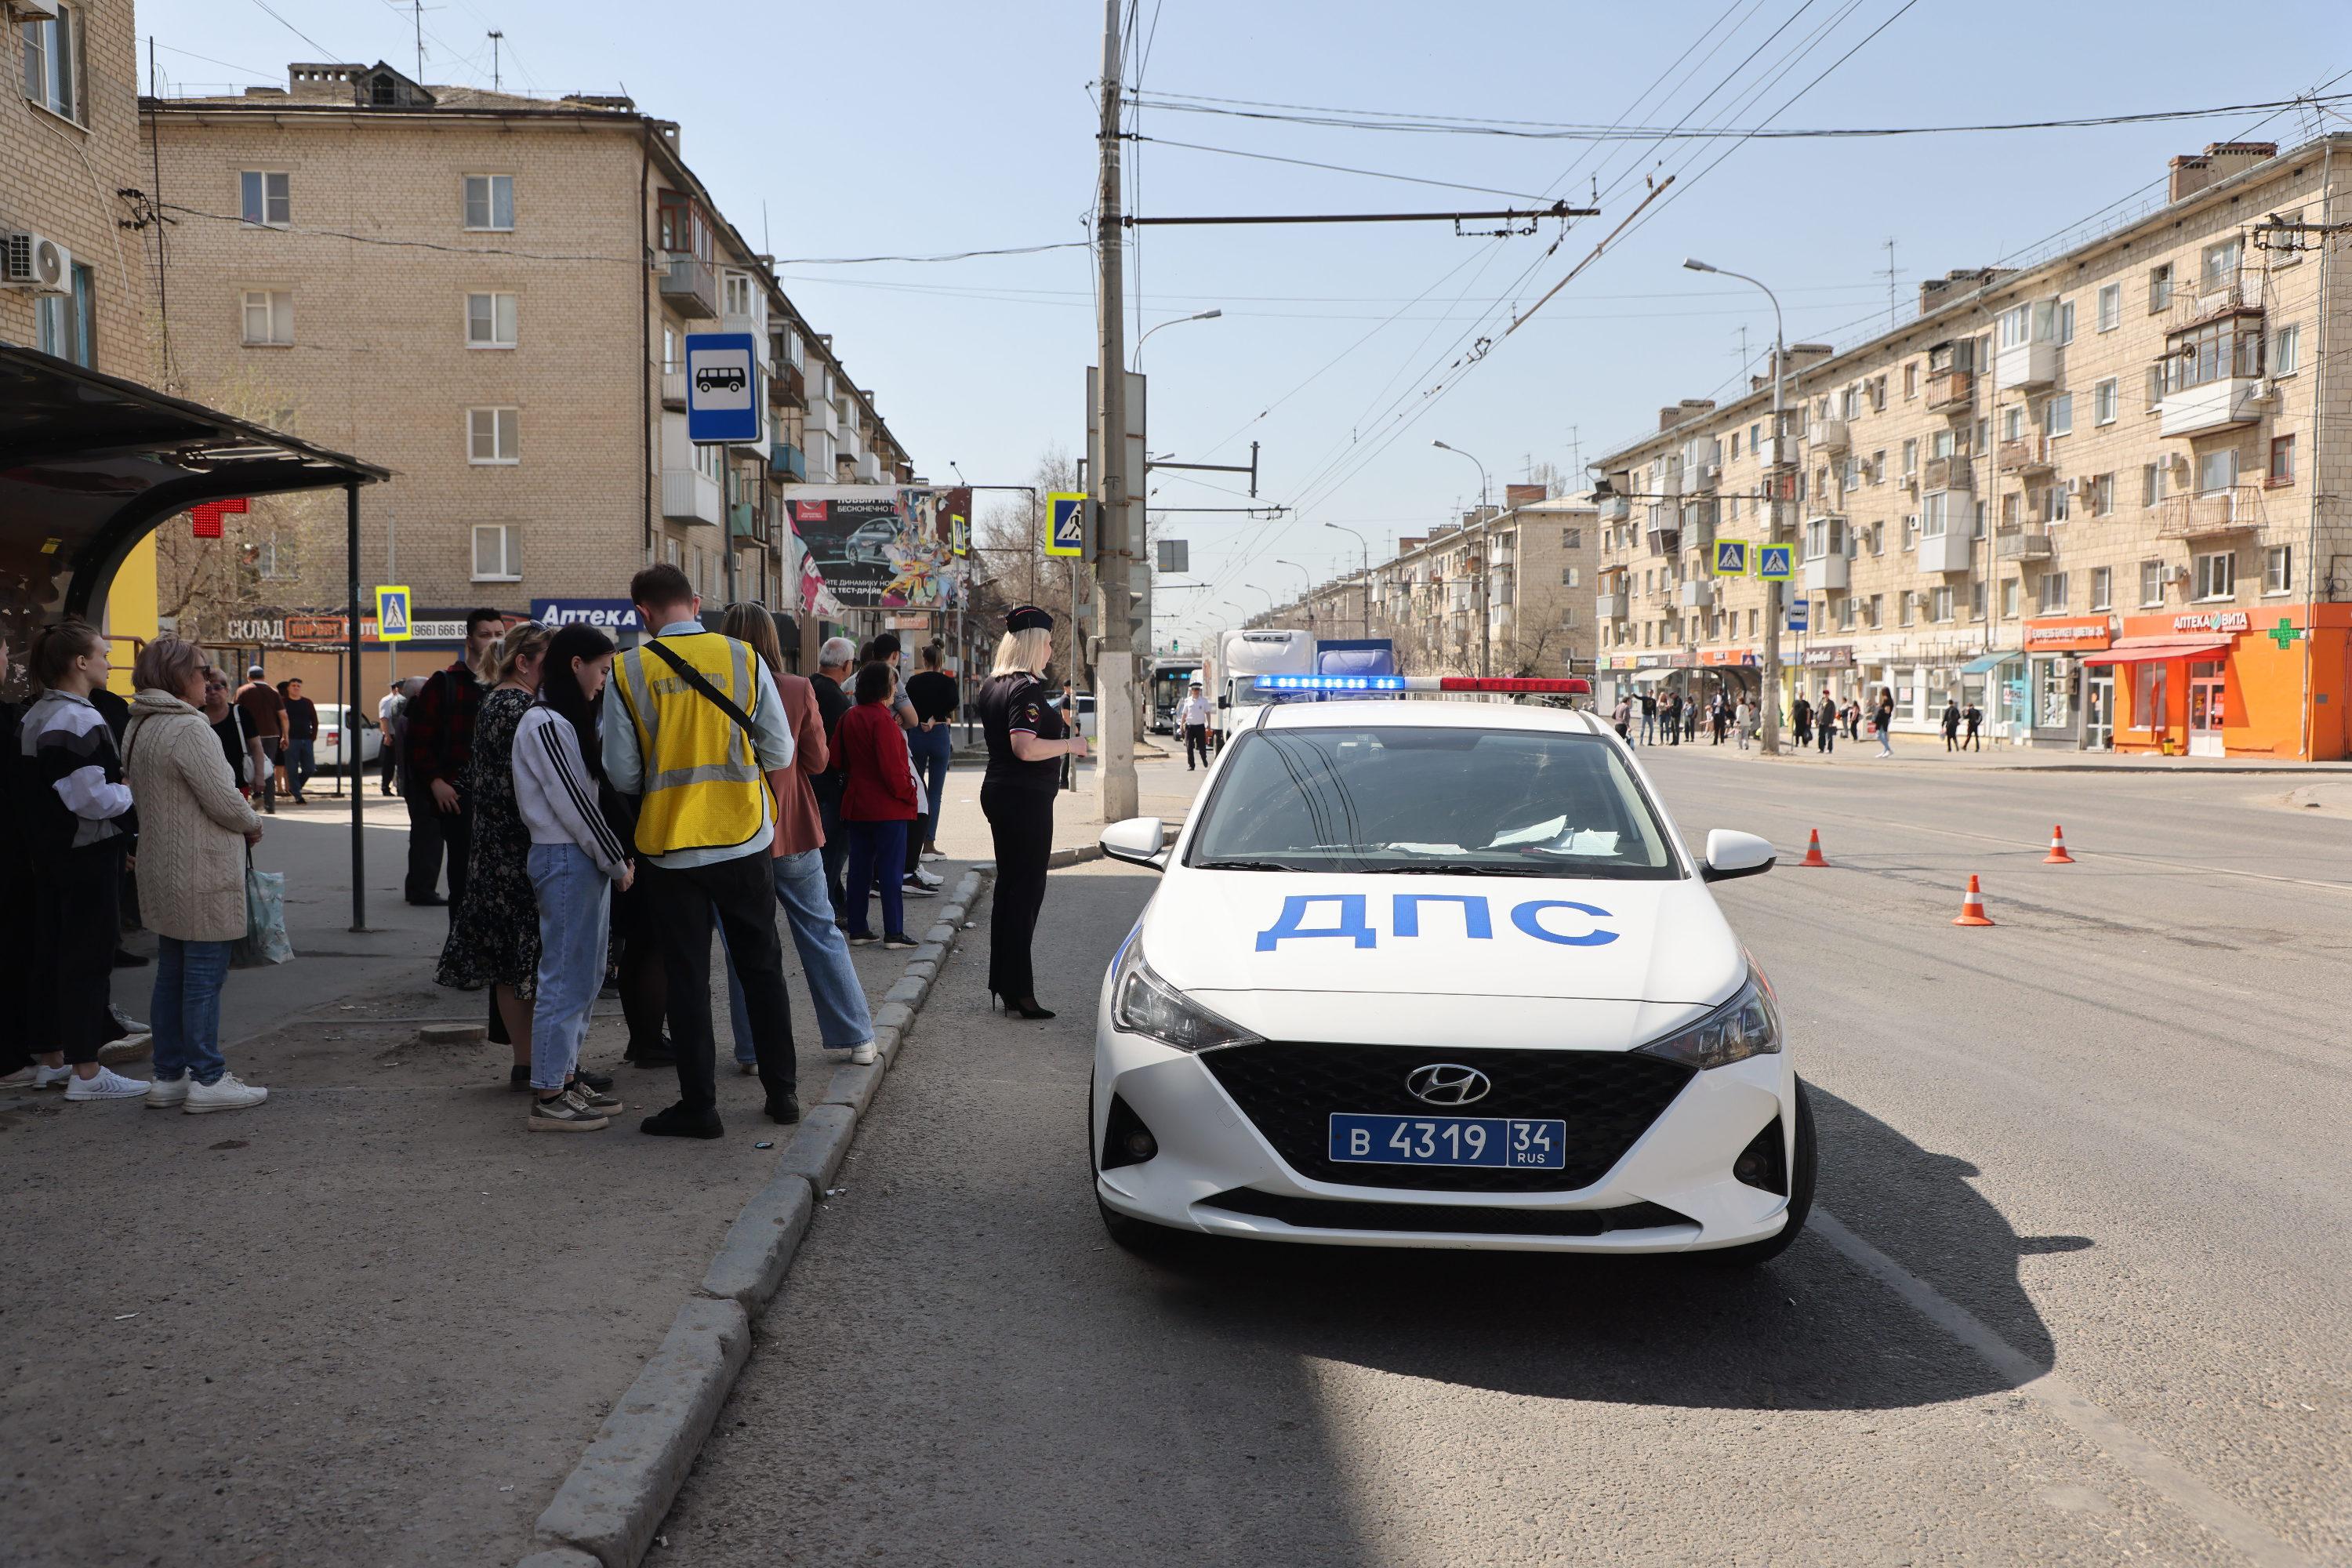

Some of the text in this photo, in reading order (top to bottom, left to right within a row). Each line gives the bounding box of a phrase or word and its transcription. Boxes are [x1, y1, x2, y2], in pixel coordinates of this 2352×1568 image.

[228, 619, 285, 641] СКЛАД
[438, 624, 455, 636] 666
[2174, 612, 2247, 629] АПТЕКА ВИТА
[1255, 895, 1620, 952] ДПС
[1388, 1122, 1486, 1160] 4319
[1513, 1123, 1550, 1152] 34
[1517, 1152, 1545, 1164] RUS
